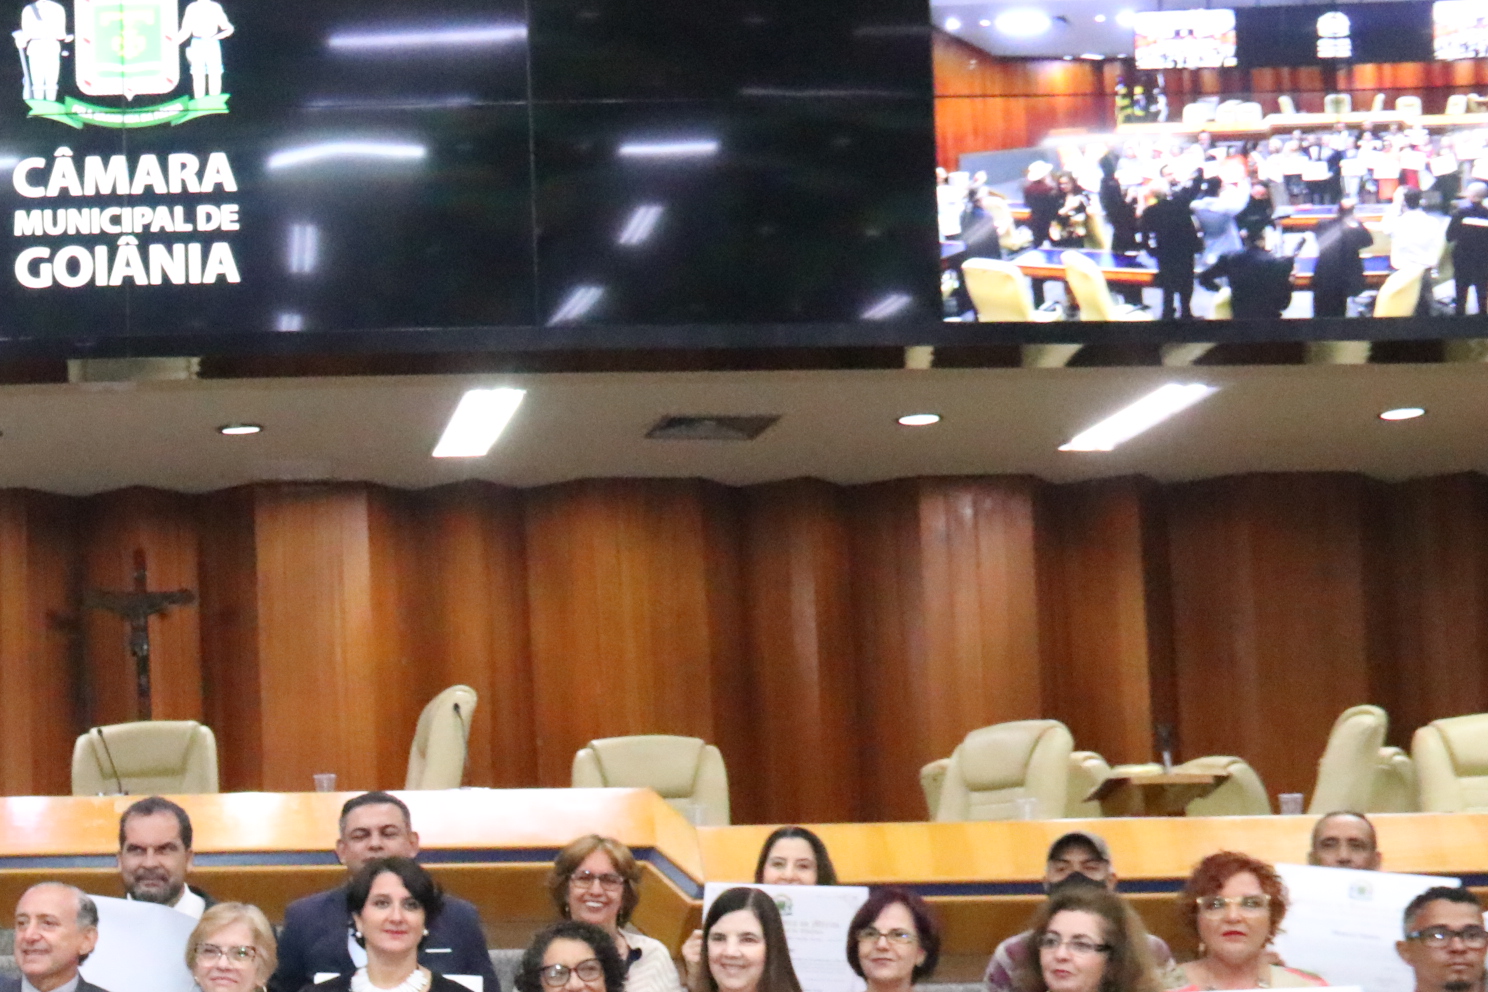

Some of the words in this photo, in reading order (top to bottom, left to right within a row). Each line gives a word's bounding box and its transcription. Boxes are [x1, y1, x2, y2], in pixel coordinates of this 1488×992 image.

[13, 146, 238, 198] CÂMARA
[14, 205, 193, 237] MUNICIPAL
[196, 204, 241, 232] DE
[14, 235, 241, 289] GOIÂNIA
